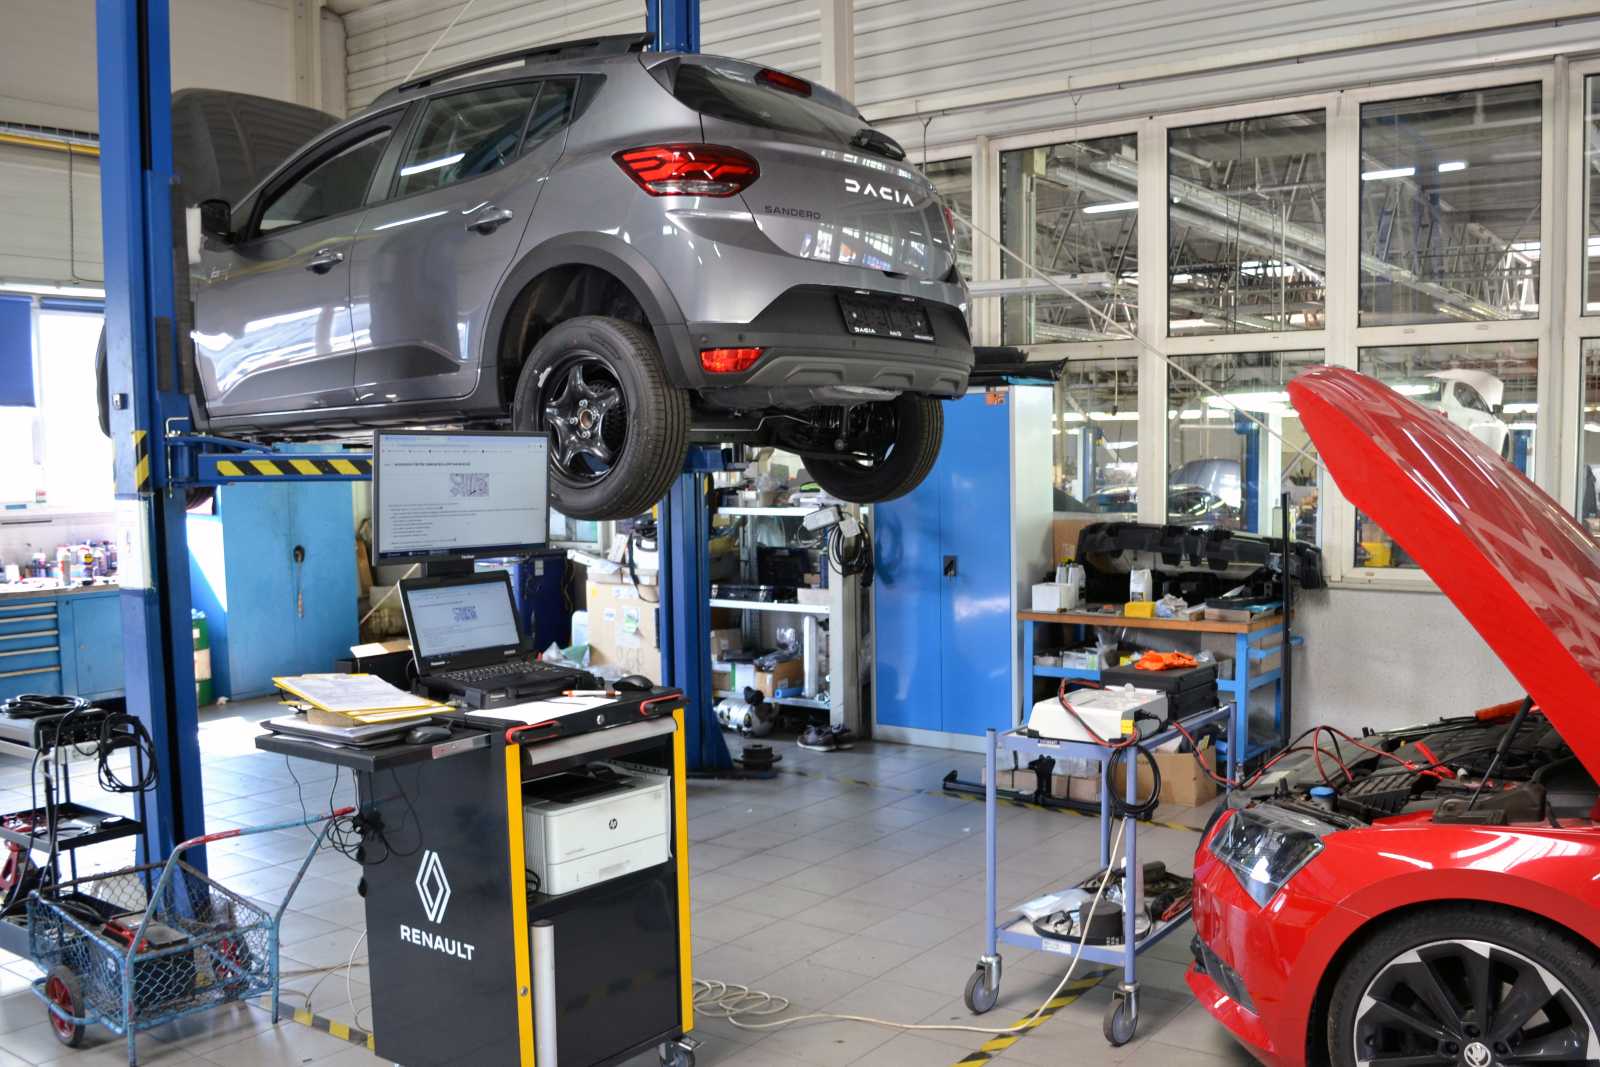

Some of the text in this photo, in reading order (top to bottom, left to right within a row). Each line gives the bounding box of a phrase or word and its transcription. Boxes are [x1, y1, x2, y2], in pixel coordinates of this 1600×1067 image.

[844, 178, 914, 207] DACIA
[764, 205, 821, 220] SANDERO
[400, 924, 475, 960] RENAULT
